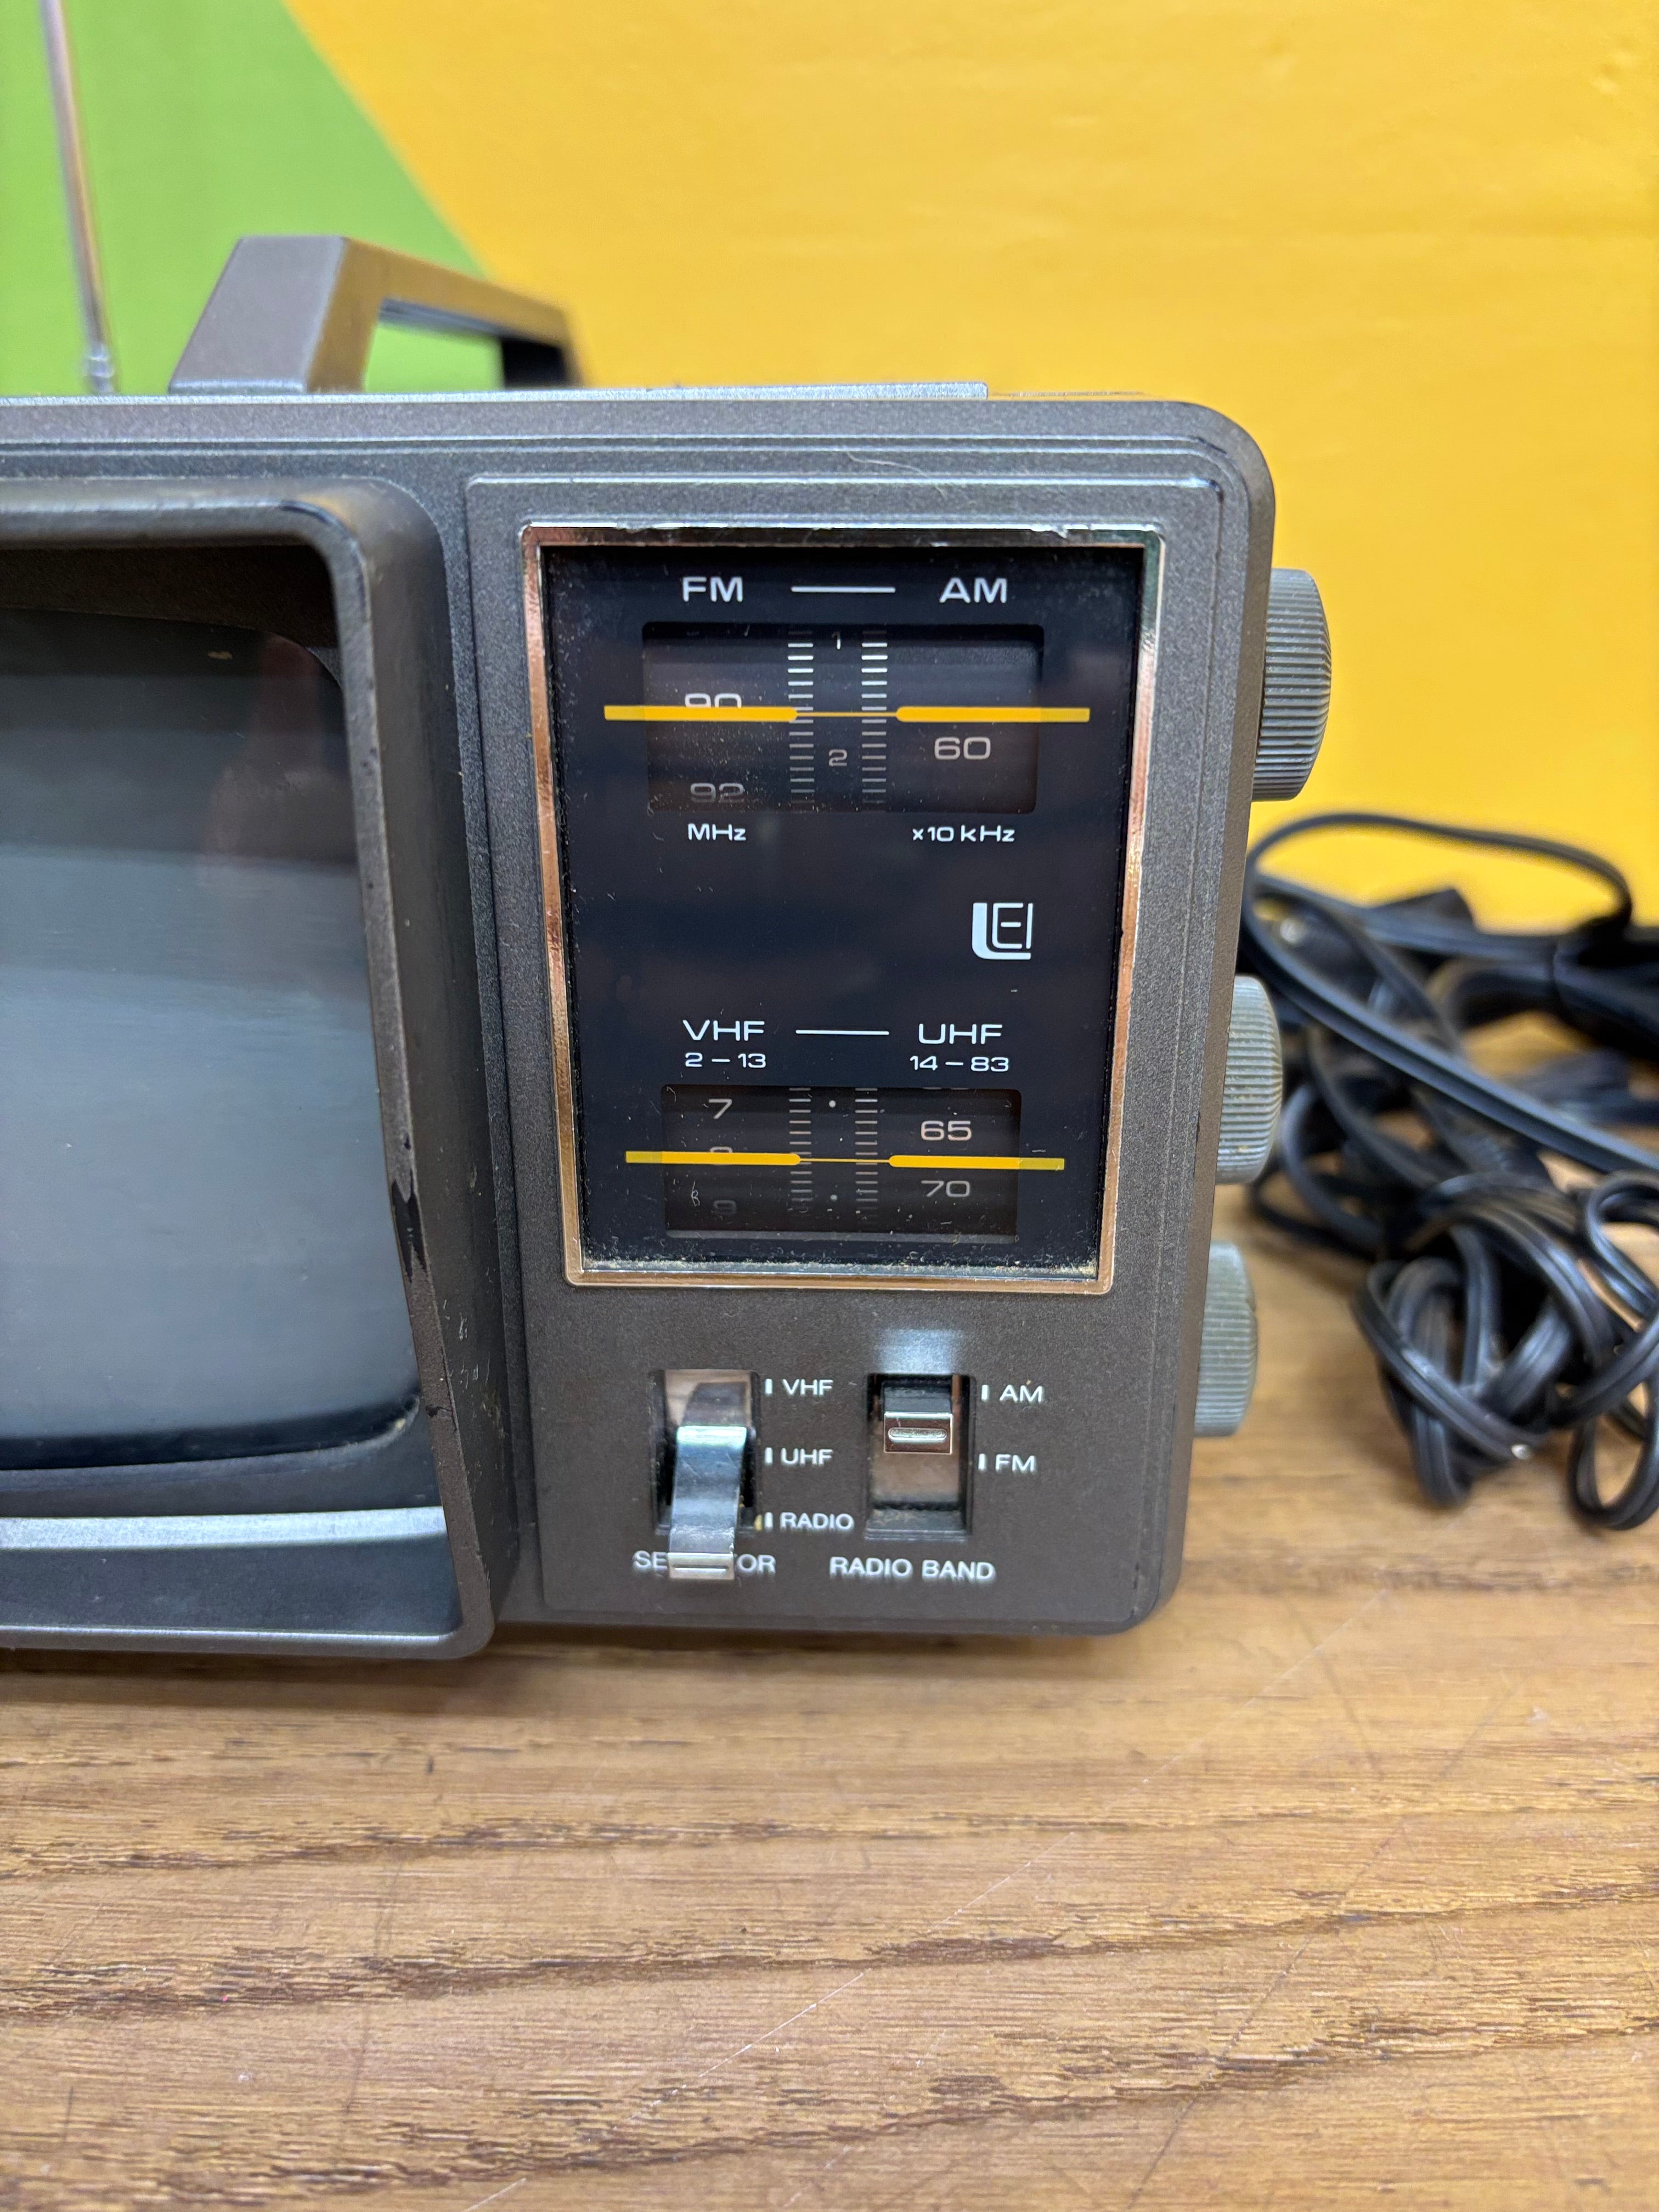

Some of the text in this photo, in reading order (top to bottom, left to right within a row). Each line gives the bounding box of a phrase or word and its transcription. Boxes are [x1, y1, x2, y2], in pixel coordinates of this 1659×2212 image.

[681, 576, 743, 603] FM
[939, 577, 1007, 603] AM
[828, 748, 848, 767] 2
[934, 736, 992, 760] 60
[690, 782, 745, 803] 92
[687, 822, 747, 841] MHz
[682, 1019, 765, 1041] VHF
[917, 1023, 1003, 1045] UHF
[708, 1098, 733, 1120] 7
[920, 1120, 972, 1142] 65
[920, 1180, 970, 1198] 70
[781, 1379, 834, 1397] VHF
[998, 1384, 1045, 1403] AM
[780, 1448, 834, 1466] UHF
[994, 1454, 1037, 1473] FM
[780, 1511, 855, 1532] RADIO
[633, 1549, 776, 1577] SEOR
[830, 1555, 996, 1583] RADIO BAND
